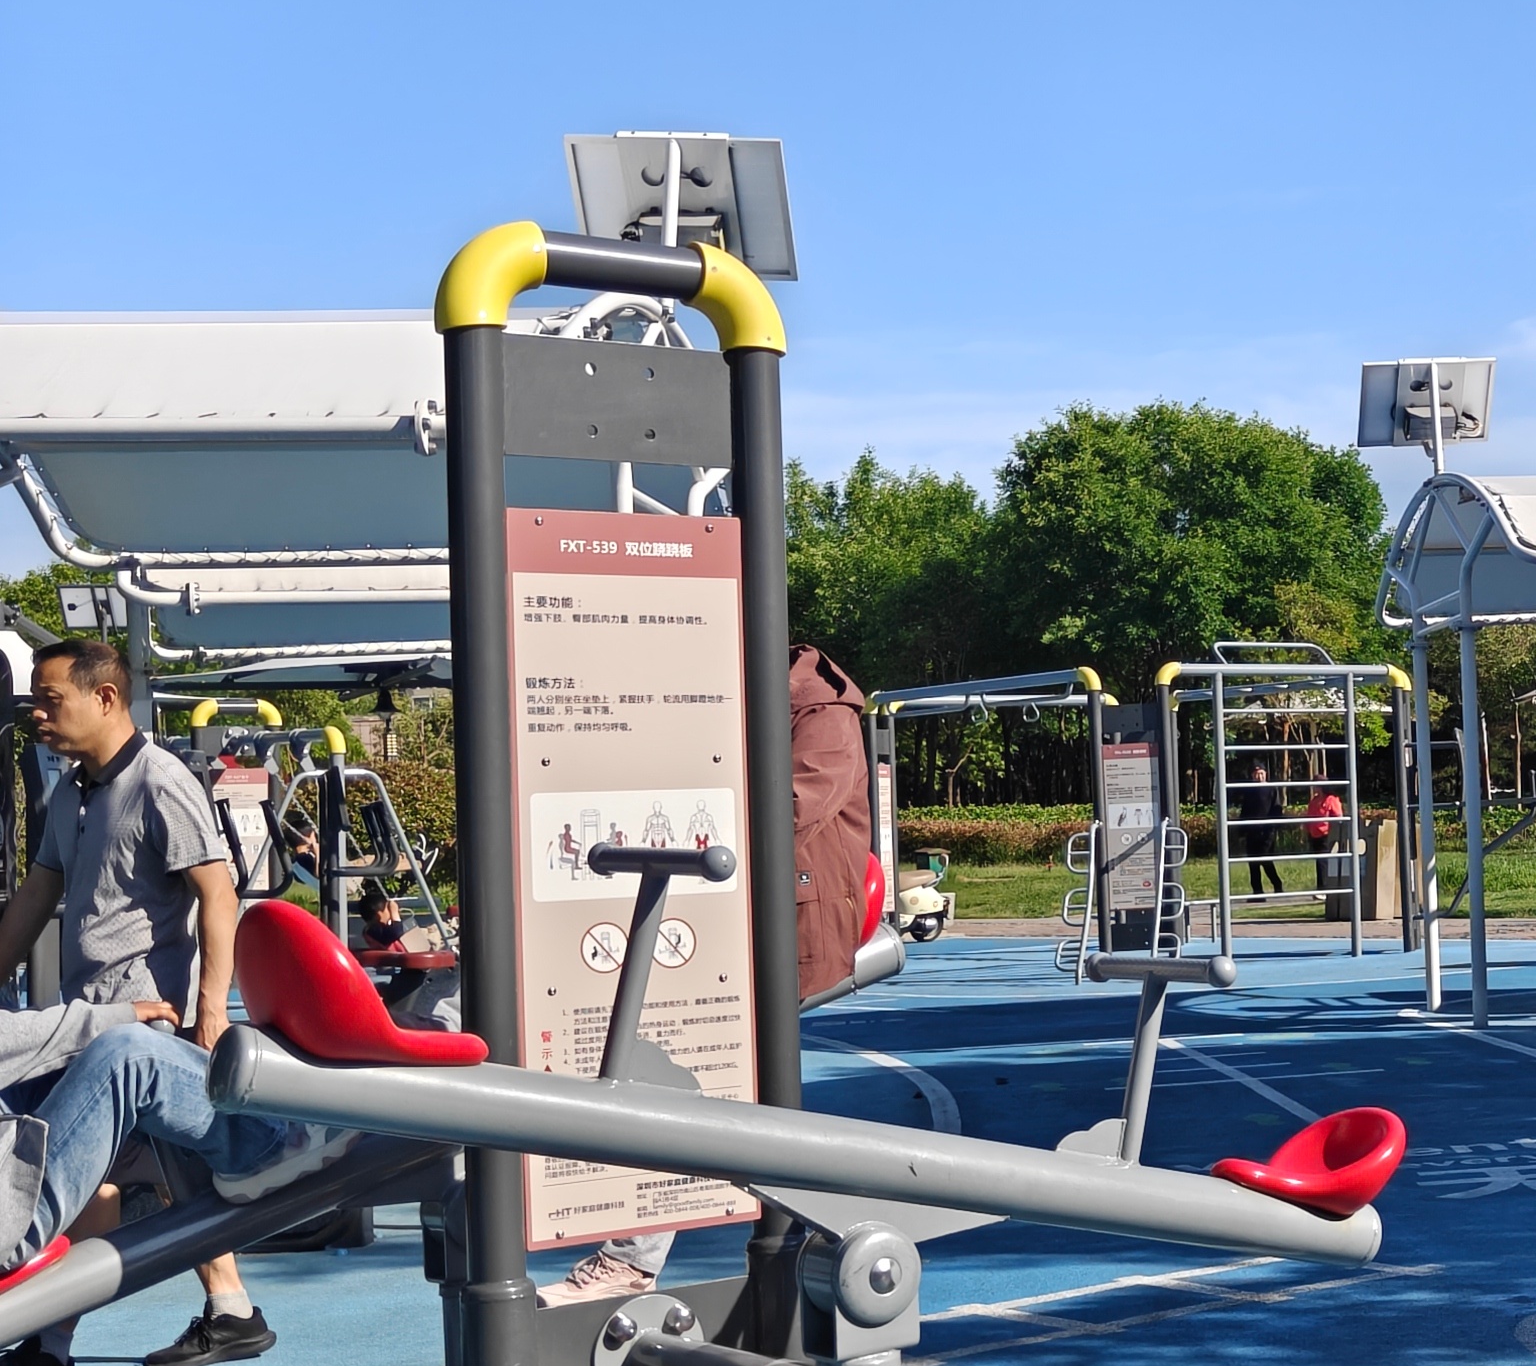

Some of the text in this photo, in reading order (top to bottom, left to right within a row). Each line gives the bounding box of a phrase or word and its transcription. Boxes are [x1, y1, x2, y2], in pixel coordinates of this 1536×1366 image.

[560, 539, 694, 559] FXT-539 双位跷跷板
[523, 595, 583, 609] 主要功能：
[525, 676, 584, 690] 锻炼方法：
[540, 1029, 554, 1061] 警示
